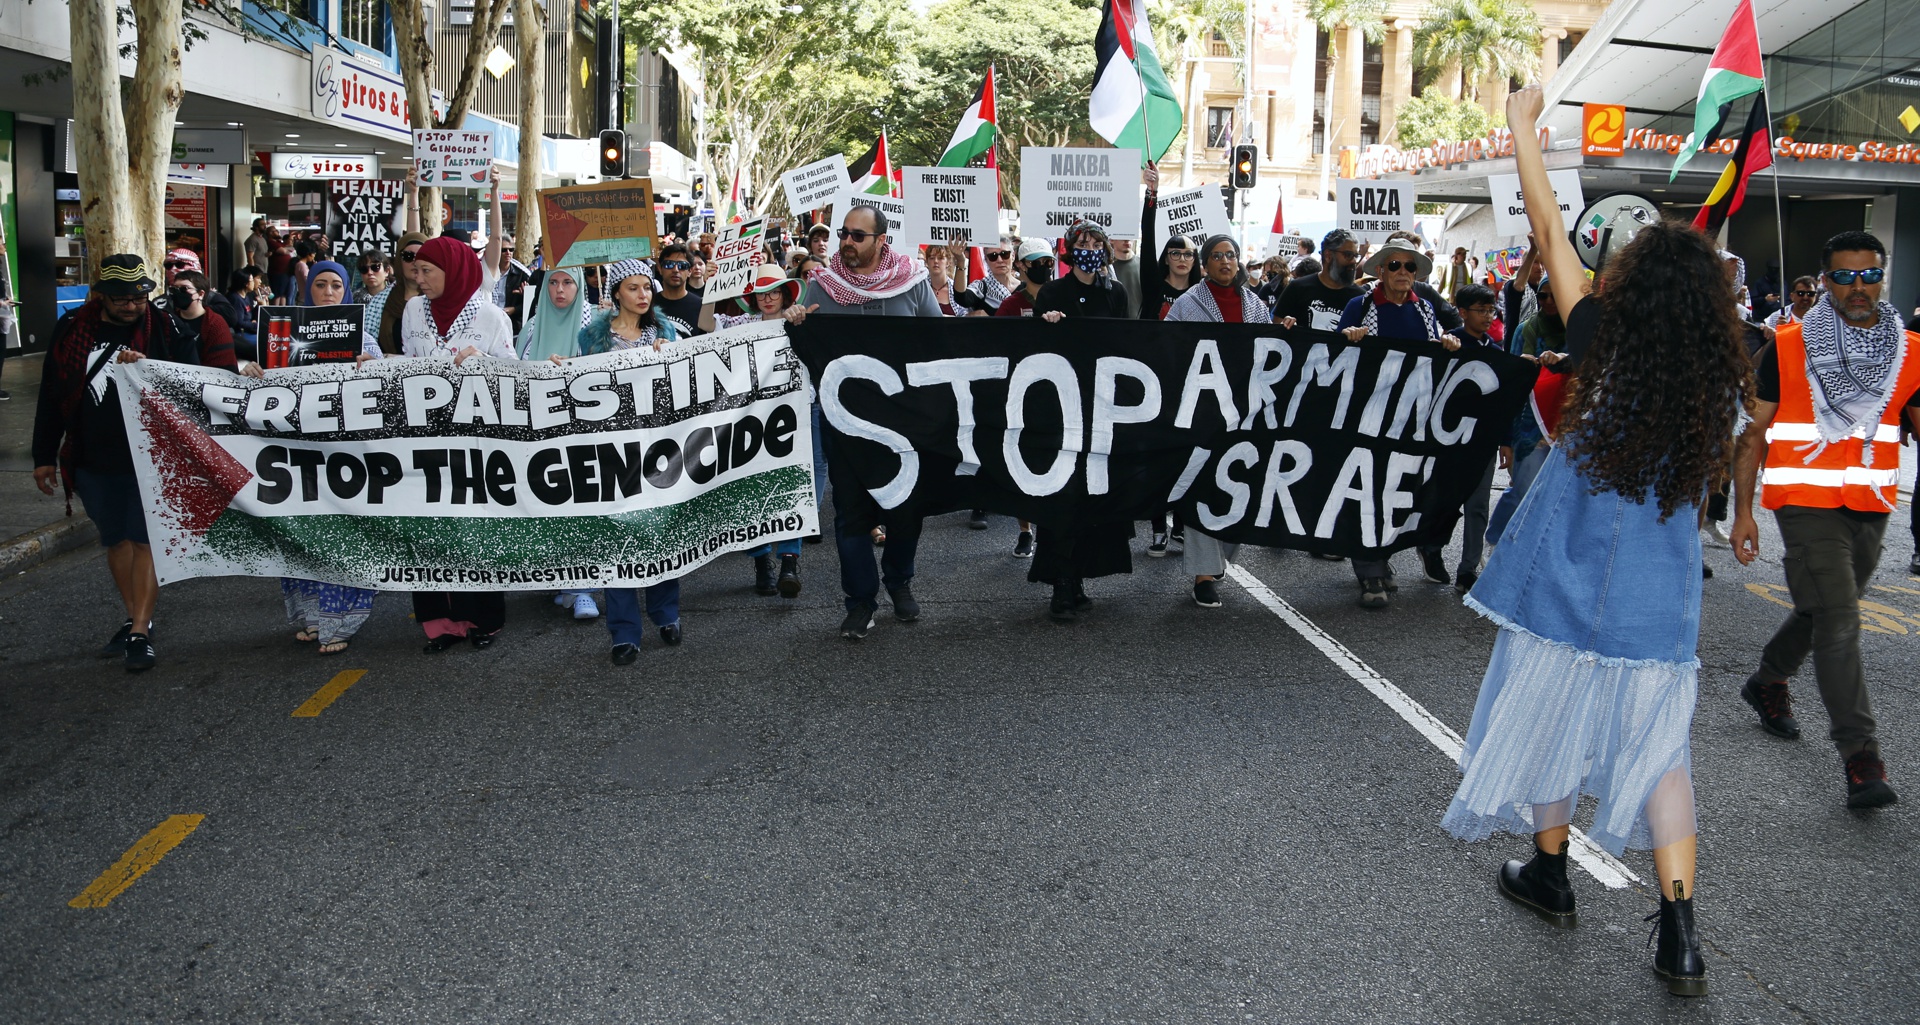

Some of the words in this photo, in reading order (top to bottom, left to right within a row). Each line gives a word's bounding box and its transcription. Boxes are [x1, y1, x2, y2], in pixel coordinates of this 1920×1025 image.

[342, 73, 386, 112] yiros
[390, 91, 399, 117] &
[426, 132, 453, 141] STOP
[462, 134, 480, 142] THE
[1629, 128, 1683, 155] King
[429, 143, 477, 154] GENOCIDE
[1382, 148, 1426, 175] George
[1430, 138, 1481, 170] Square
[1487, 128, 1549, 158] Stan
[1777, 136, 1857, 162] Square
[1862, 141, 1920, 164] Statio
[313, 160, 364, 174] yiros
[415, 158, 436, 171] FREE
[443, 154, 491, 167] PALESTINE
[1050, 153, 1110, 177] NAKBA
[792, 175, 806, 183] FREE
[806, 163, 835, 179] PALESTINE
[922, 174, 938, 184] FREE
[940, 174, 976, 186] PALESTINE
[332, 181, 403, 198] HEALTH
[795, 185, 808, 194] END
[808, 174, 838, 189] APARTHEID
[1047, 180, 1082, 191] ONGOING
[1084, 181, 1113, 192] ETHNIC
[578, 193, 594, 205] the
[595, 191, 617, 205] River
[619, 192, 628, 202] to
[631, 192, 644, 202] the
[799, 194, 814, 204] STOP
[934, 188, 965, 203] EXIST!
[1057, 196, 1102, 208] CLEANSING
[1156, 201, 1170, 209] FREE
[1171, 190, 1203, 206] PALESTINE
[1350, 187, 1401, 216] GAZA
[338, 196, 392, 214] CARE
[1168, 204, 1197, 220] EXIST!
[348, 213, 379, 223] NOT
[573, 211, 620, 224] Palestine
[624, 213, 637, 221] will
[932, 207, 969, 222] RESIST!
[342, 223, 390, 241] WAR
[1169, 218, 1203, 236] RESIST!
[1350, 220, 1364, 230] END
[1366, 220, 1379, 230] THE
[1381, 220, 1401, 231] SIEGE
[720, 229, 734, 243] I
[931, 226, 972, 242] RETURN!
[1280, 236, 1299, 244] JUSTIC
[715, 234, 762, 259] REFUSE
[718, 263, 730, 275] TO
[709, 270, 752, 294] AWAY!
[298, 325, 330, 334] RIGHT
[332, 323, 356, 332] SIDE
[300, 349, 317, 362] Free
[317, 351, 353, 359] PALESTINE
[201, 377, 385, 434] FREE
[401, 335, 793, 430] PALESTINE
[819, 352, 1162, 510] STOP
[1173, 337, 1500, 446] ARMING
[255, 444, 404, 505] STOP
[458, 568, 493, 583] FOR
